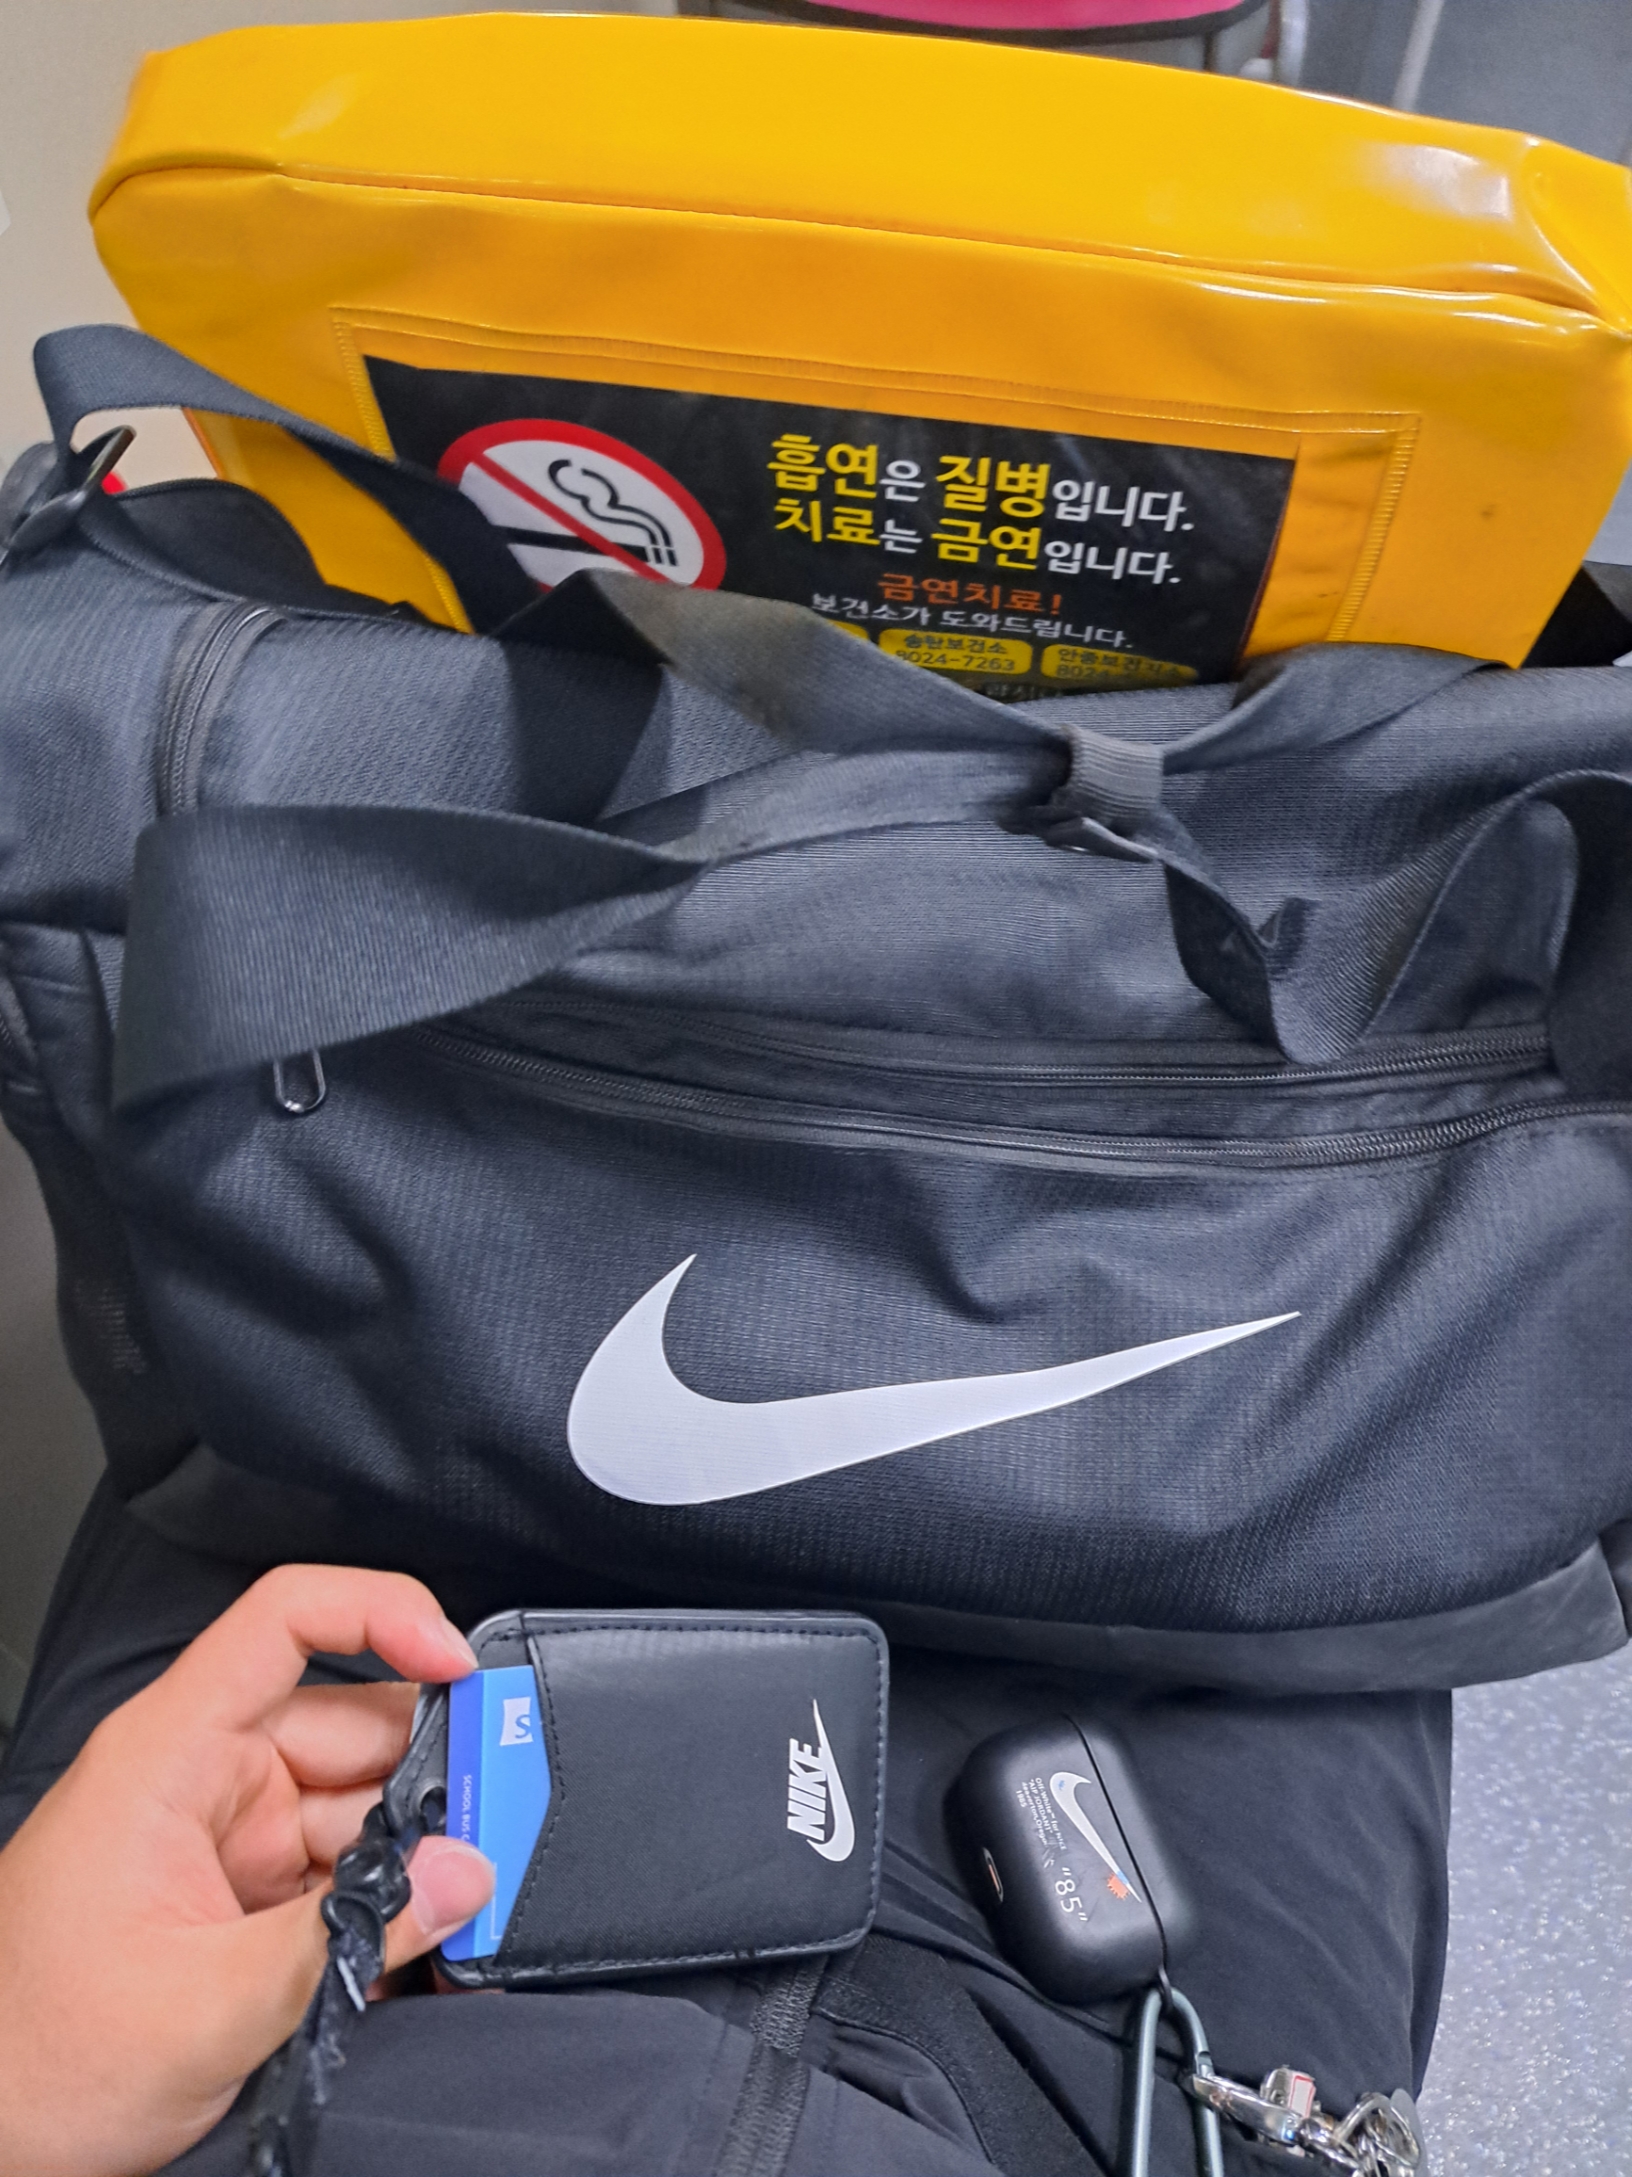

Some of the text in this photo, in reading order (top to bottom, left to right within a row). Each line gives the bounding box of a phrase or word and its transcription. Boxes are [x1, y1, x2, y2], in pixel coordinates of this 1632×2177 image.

[767, 433, 1194, 532] 흡연은 질병입니다.
[774, 498, 1182, 584] 치료는 금연입니다.
[812, 593, 1134, 648] 보건소가 도와드립니다.
[877, 573, 1062, 615] 금연치료!
[461, 1774, 473, 1813] SCHOOL
[787, 1738, 827, 1842] NIKE
